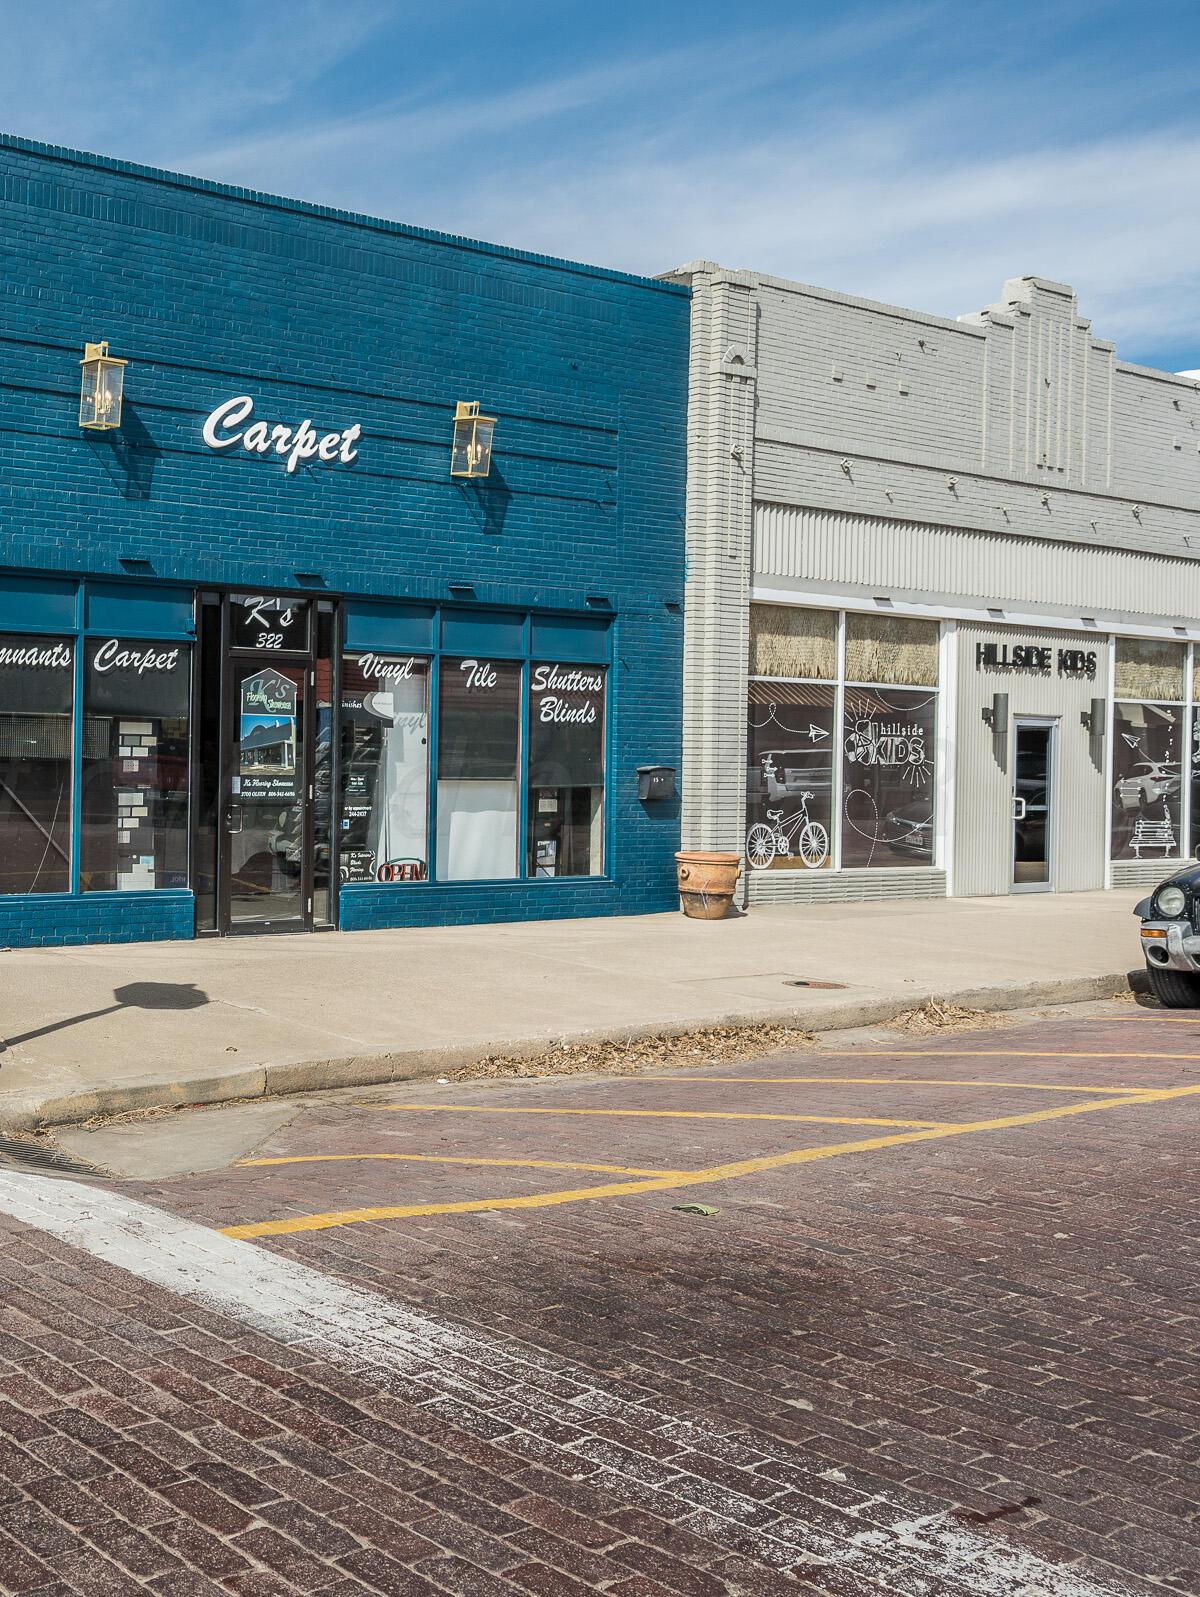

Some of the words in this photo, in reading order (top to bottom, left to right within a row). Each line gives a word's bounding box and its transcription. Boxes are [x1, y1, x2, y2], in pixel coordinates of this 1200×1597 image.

[203, 396, 361, 473] Carpet
[244, 596, 294, 628] K's
[255, 632, 284, 649] 322
[93, 638, 179, 674] Carpet
[358, 653, 415, 685] Vinyl
[975, 642, 1052, 669] HILLSIDE
[1057, 648, 1097, 673] KIDS
[460, 659, 497, 689] Tile
[531, 664, 602, 691] Shutters
[540, 696, 596, 723] Blinds
[871, 723, 925, 765] KIDS
[880, 722, 924, 737] hillside
[378, 862, 426, 882] OPEN
